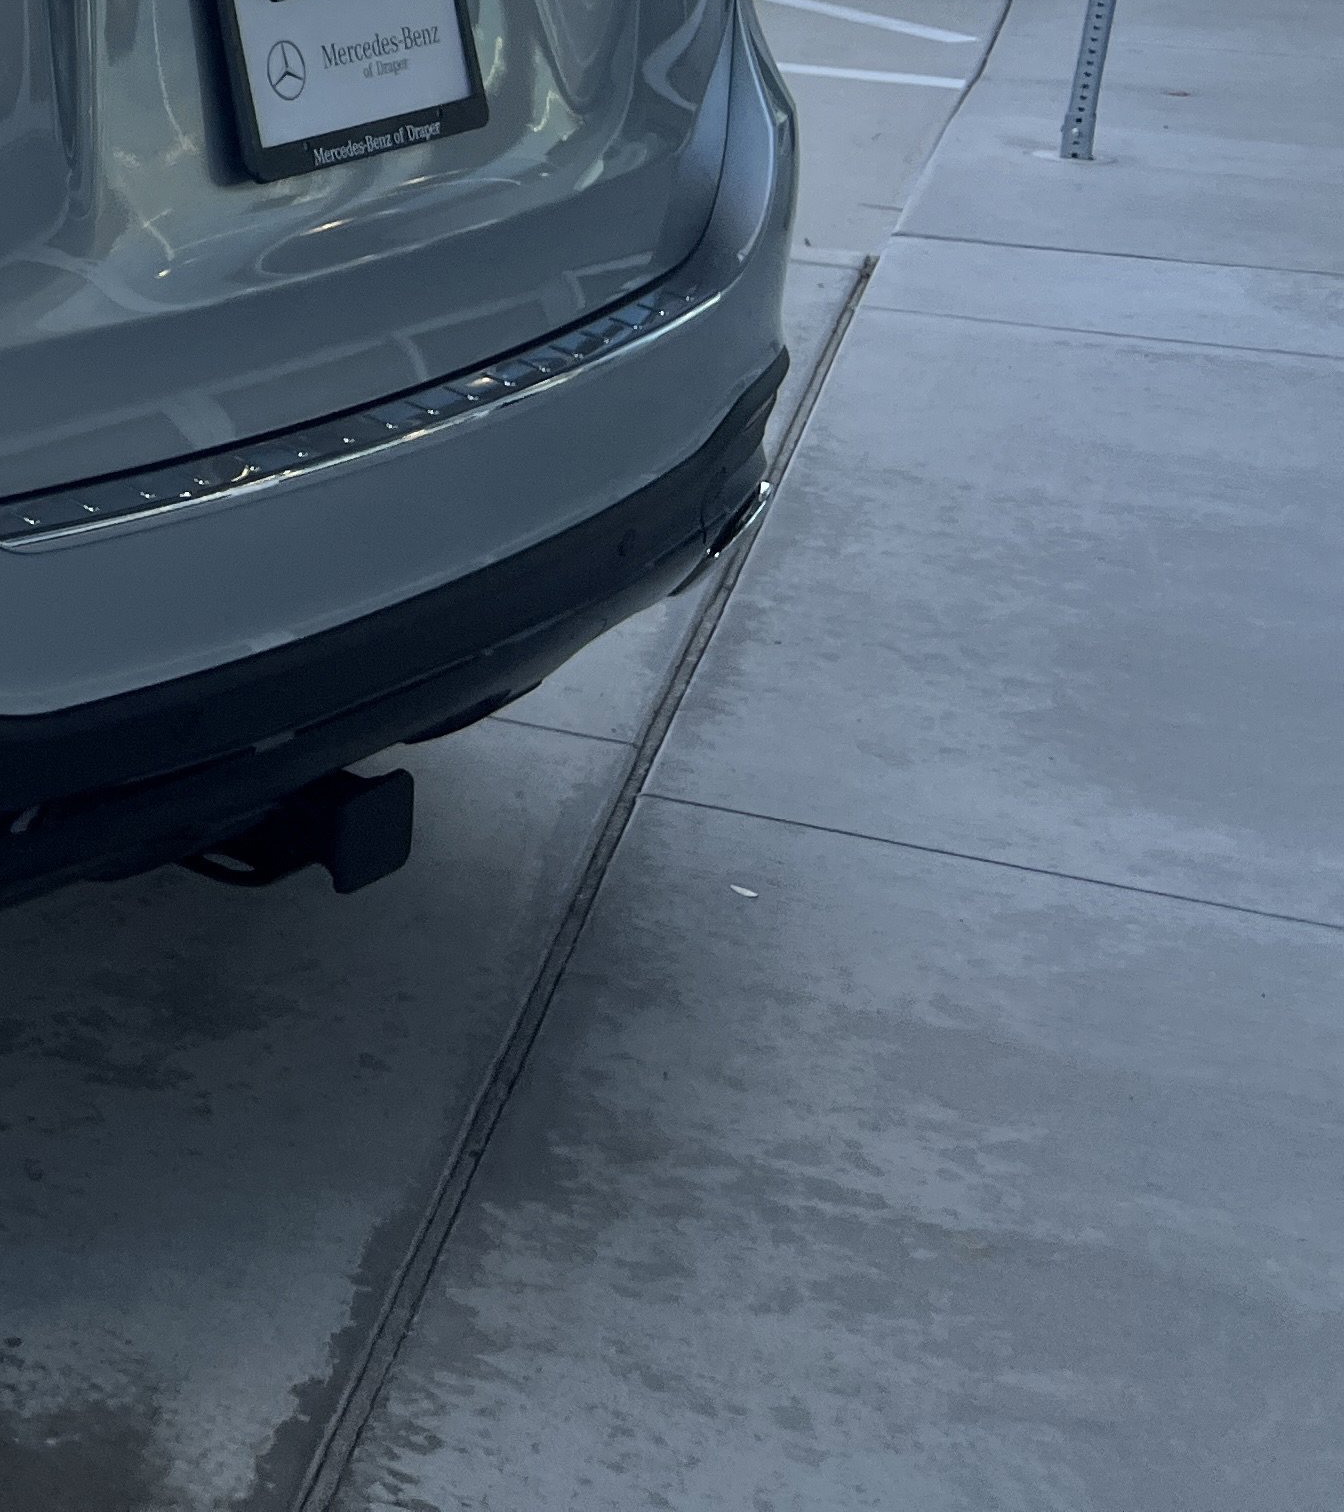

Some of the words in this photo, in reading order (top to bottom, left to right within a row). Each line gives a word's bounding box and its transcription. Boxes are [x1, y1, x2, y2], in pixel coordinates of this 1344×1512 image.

[320, 26, 440, 69] Mercedes-Benz
[363, 63, 373, 78] of
[313, 133, 392, 166] Mercedes-Benz
[393, 127, 405, 144] of
[406, 121, 441, 141] Draper
